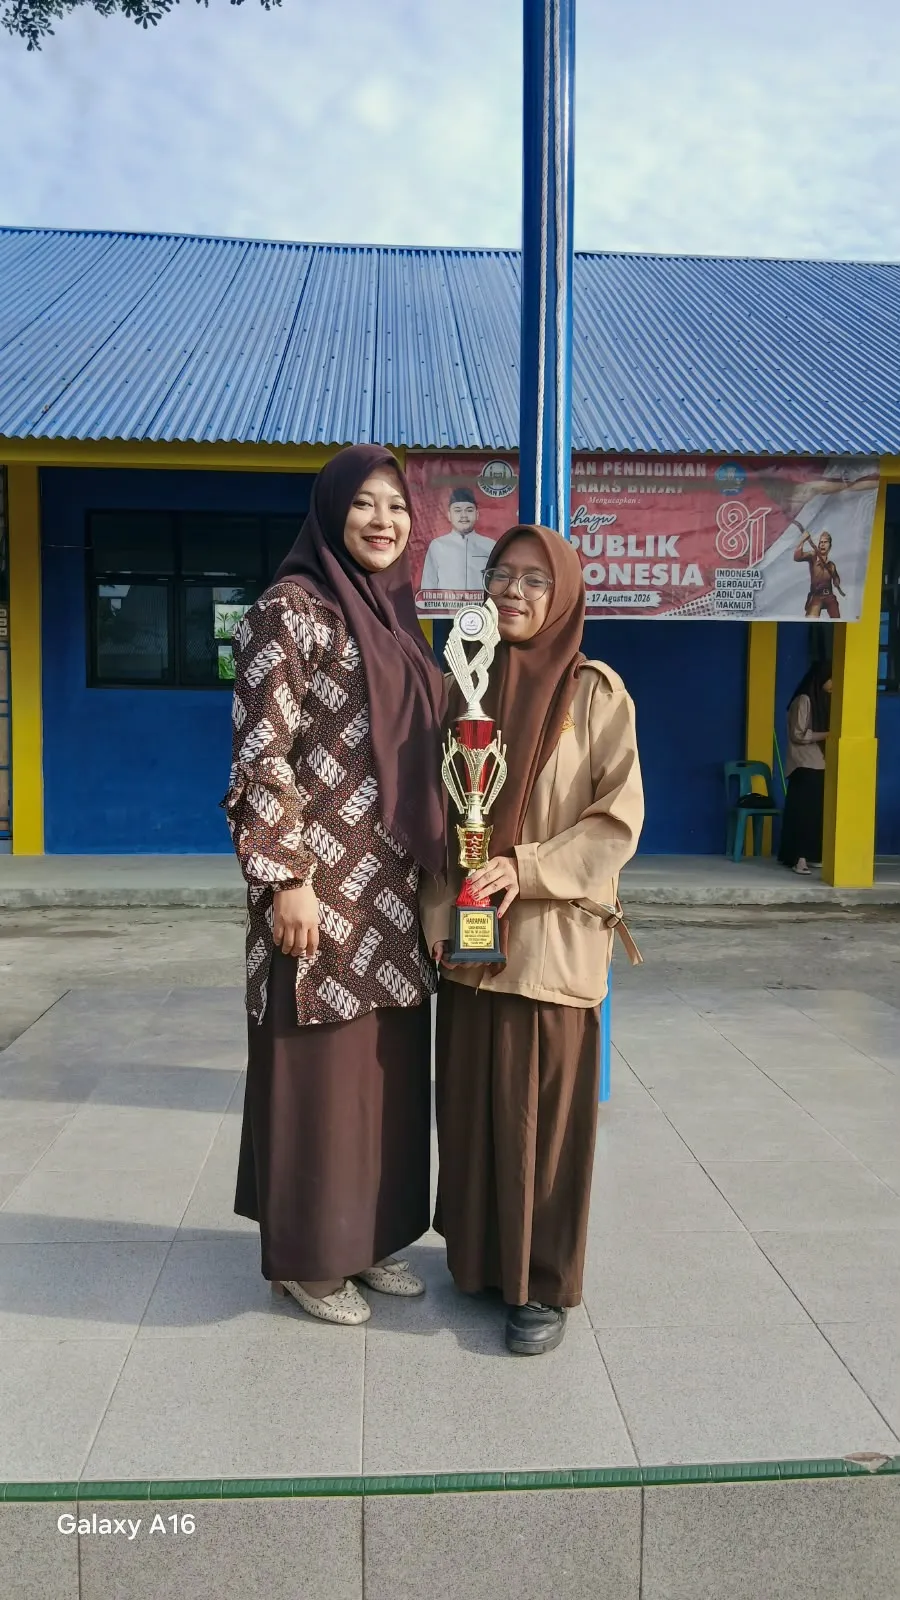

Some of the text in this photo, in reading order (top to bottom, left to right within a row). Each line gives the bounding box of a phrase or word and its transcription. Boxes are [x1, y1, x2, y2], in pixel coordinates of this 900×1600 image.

[572, 462, 707, 475] AN PENDIDIKAN
[588, 497, 636, 507] Mengucapkan
[716, 501, 771, 567] 81
[584, 563, 704, 586] ONESIA
[717, 570, 759, 578] INDONESIA
[717, 581, 762, 589] BERDAULAT
[592, 594, 600, 602] 17
[602, 593, 632, 604] Agustus
[634, 593, 651, 602] 2026
[716, 591, 752, 599] ADIL DAN
[716, 602, 752, 610] MAKMUR
